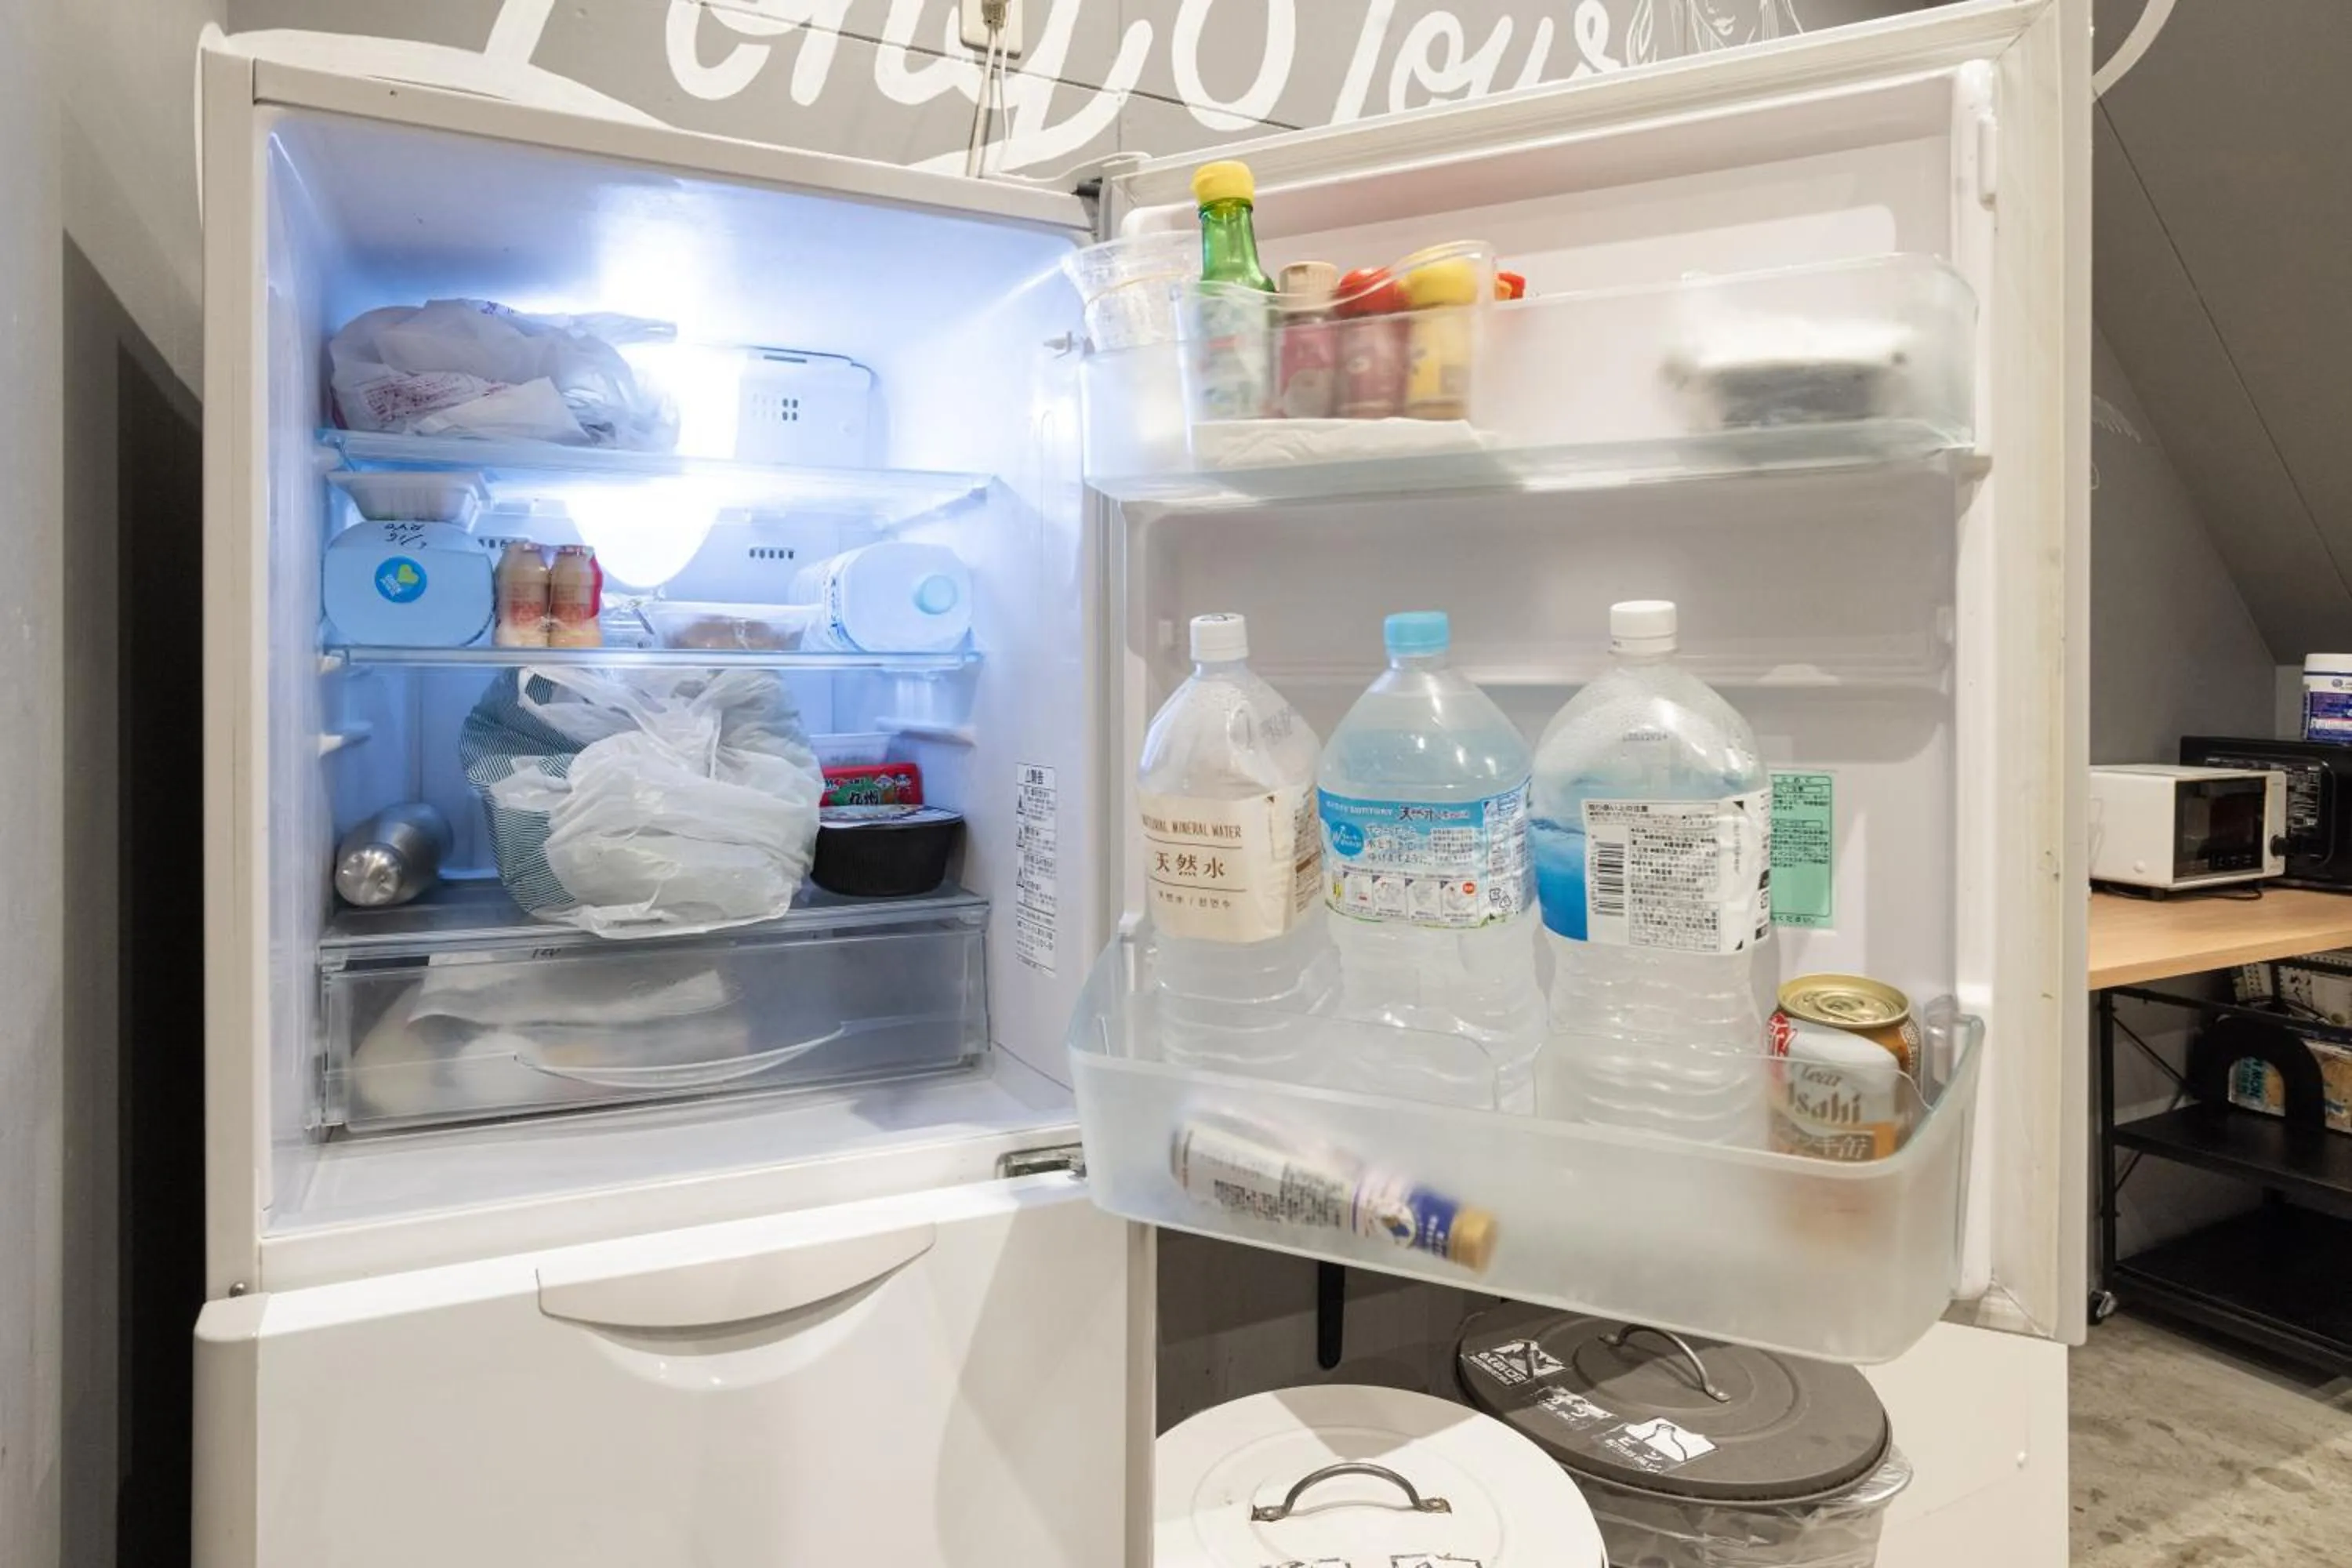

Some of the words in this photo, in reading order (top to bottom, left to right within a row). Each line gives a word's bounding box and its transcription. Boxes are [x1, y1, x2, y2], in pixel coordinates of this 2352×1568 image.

[1171, 821, 1208, 837] MINERAL
[1210, 823, 1242, 839] WATER
[1156, 851, 1226, 879] 天然水
